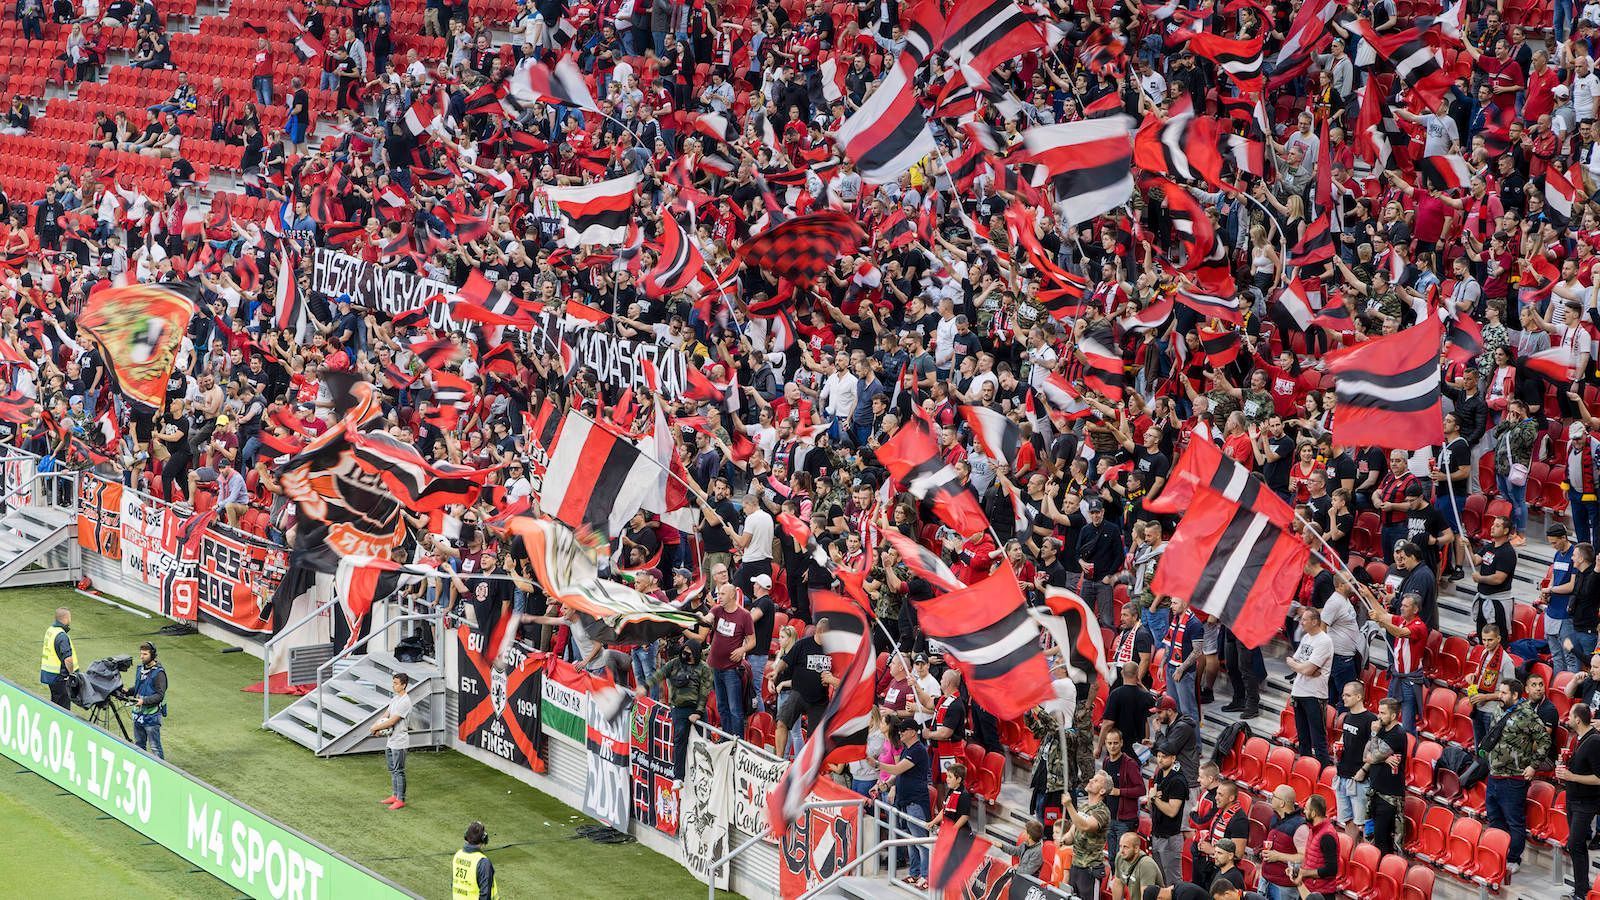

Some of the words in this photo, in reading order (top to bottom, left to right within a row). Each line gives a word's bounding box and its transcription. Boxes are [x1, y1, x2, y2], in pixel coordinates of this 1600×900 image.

[313, 248, 368, 306] HISZEK
[516, 698, 537, 719] 1991
[481, 729, 515, 762] FINEST
[87, 742, 151, 824] 17:30
[187, 793, 224, 867] M4
[230, 820, 324, 900] SPORT
